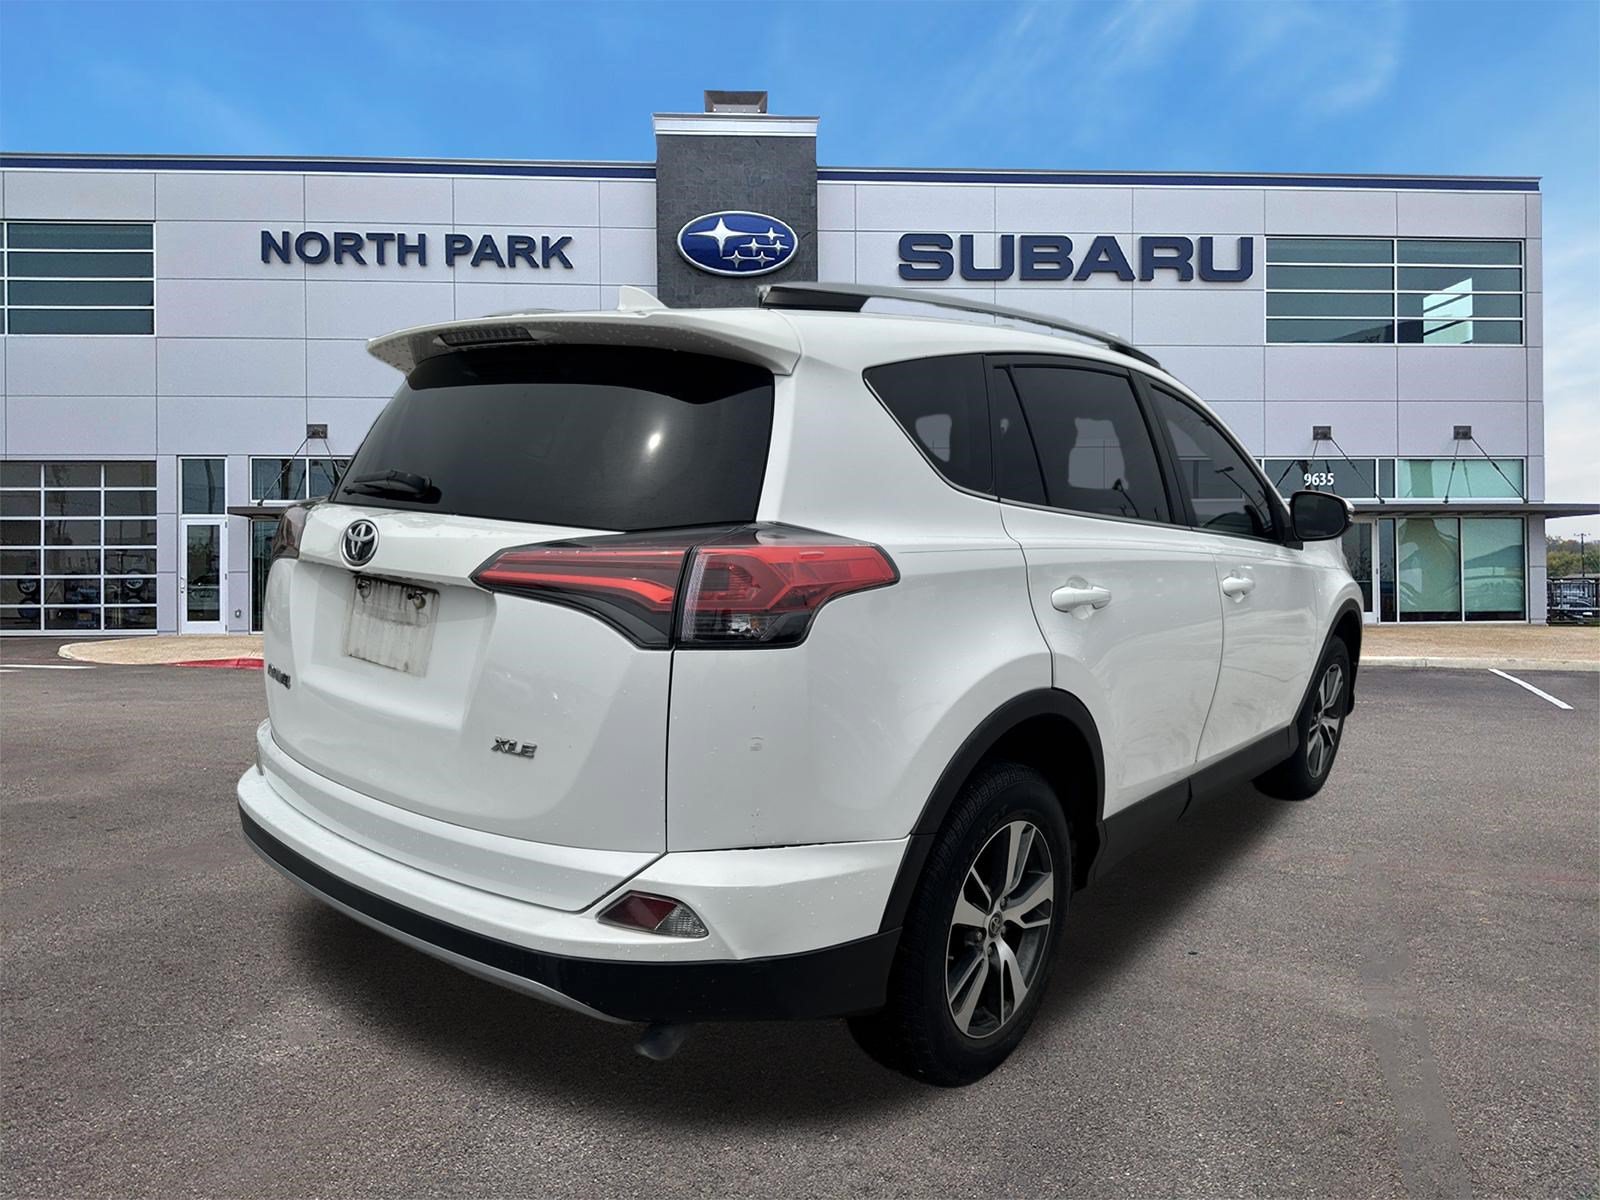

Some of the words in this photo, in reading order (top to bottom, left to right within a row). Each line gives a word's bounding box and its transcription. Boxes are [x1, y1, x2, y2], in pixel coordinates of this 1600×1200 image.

[260, 230, 427, 266] NORTH
[445, 233, 574, 269] PARK
[898, 233, 1253, 282] SUBARU
[1303, 472, 1335, 486] 9635
[491, 736, 538, 759] XLE
